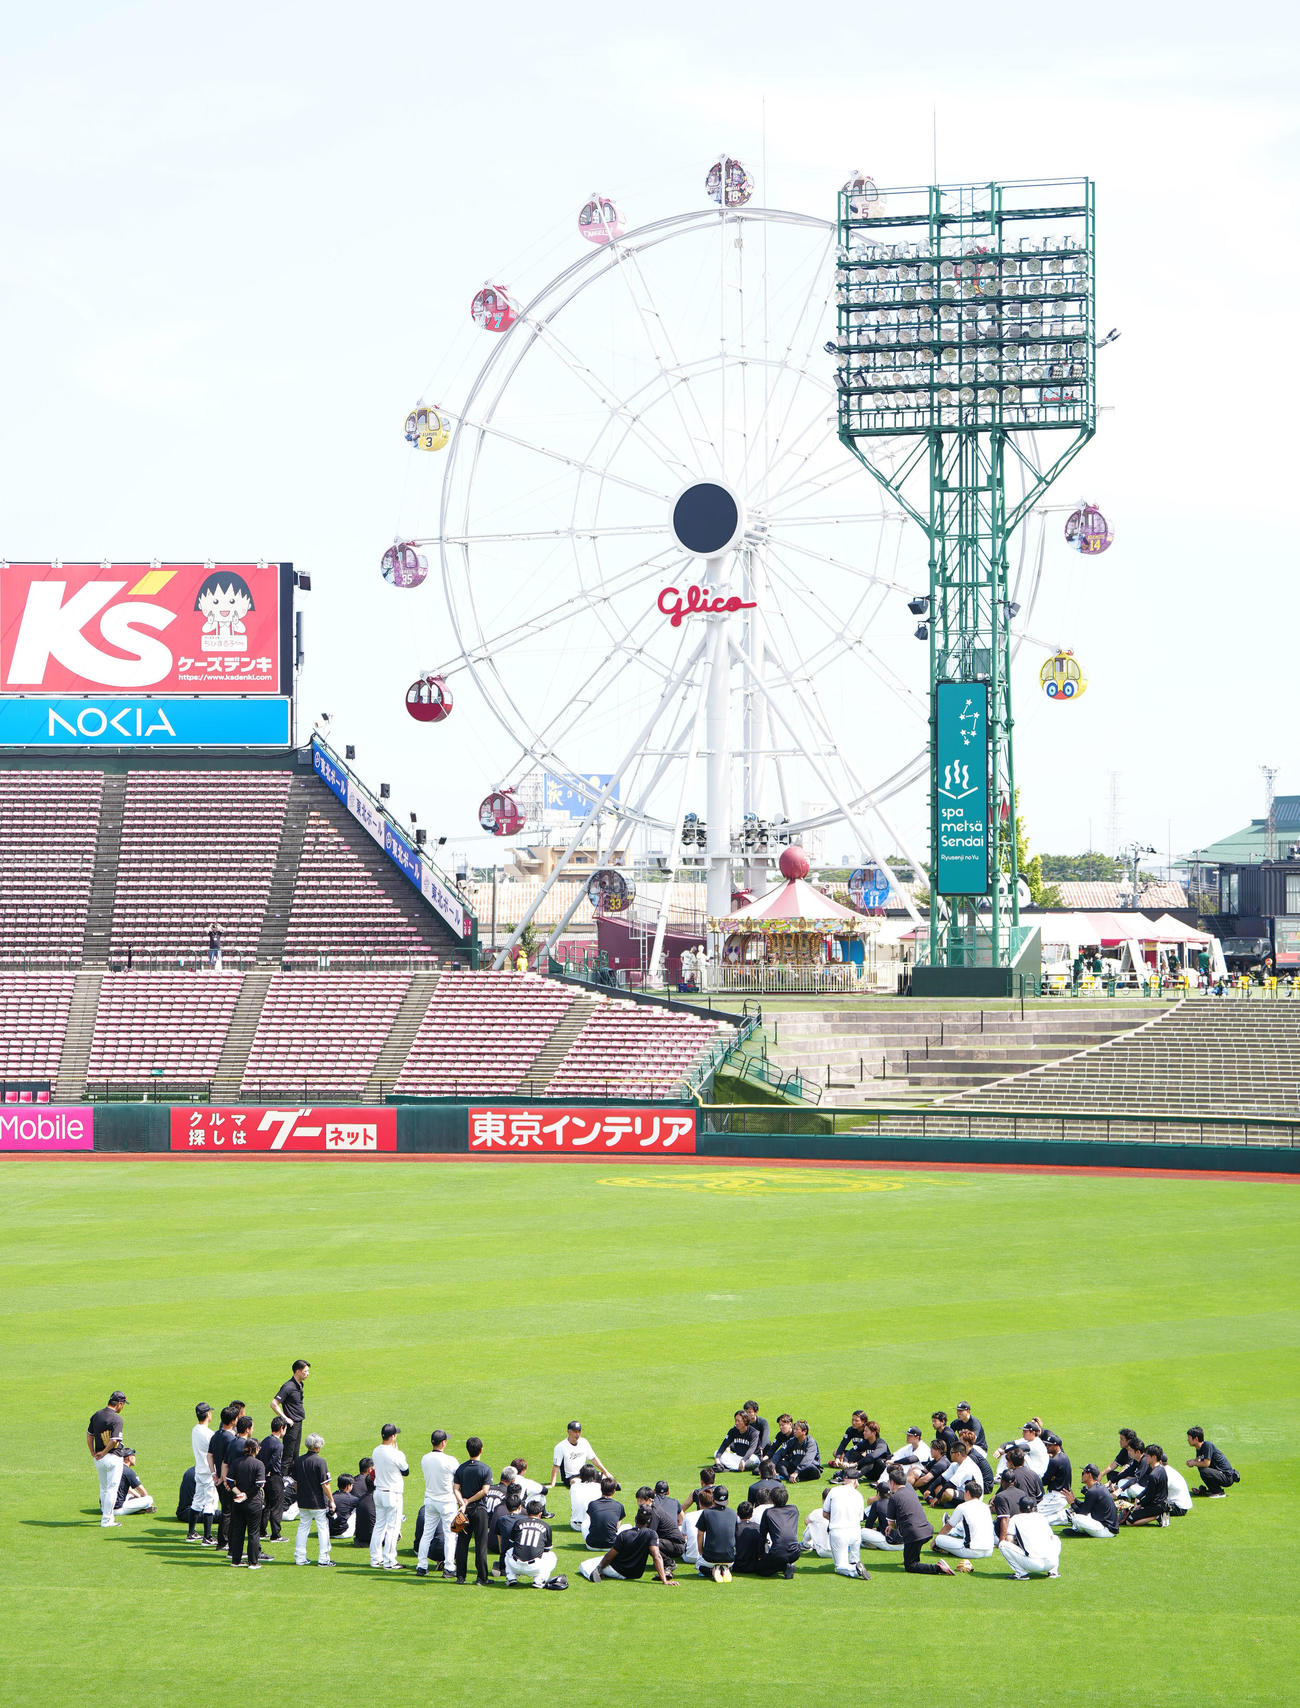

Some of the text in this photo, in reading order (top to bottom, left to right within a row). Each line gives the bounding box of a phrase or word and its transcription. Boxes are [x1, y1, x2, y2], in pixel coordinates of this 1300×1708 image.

[494, 316, 502, 329] 7
[425, 436, 433, 448] 3
[1090, 539, 1101, 552] 14
[657, 585, 758, 628] Glico
[177, 656, 272, 673] ケーズデンキ
[48, 707, 177, 737] NOKIA
[320, 757, 346, 796] 東北ボール
[941, 808, 963, 820] spa
[502, 823, 507, 834] 1
[941, 820, 983, 832] metsä
[941, 835, 984, 847] Sendai
[391, 844, 420, 879] 東北ボール
[610, 898, 621, 910] 33
[0, 1114, 84, 1140] Mobile
[189, 1112, 247, 1127] クルマ
[472, 1112, 693, 1147] 東京インテリア
[189, 1130, 247, 1146] 探しは
[520, 1529, 541, 1548] 111
